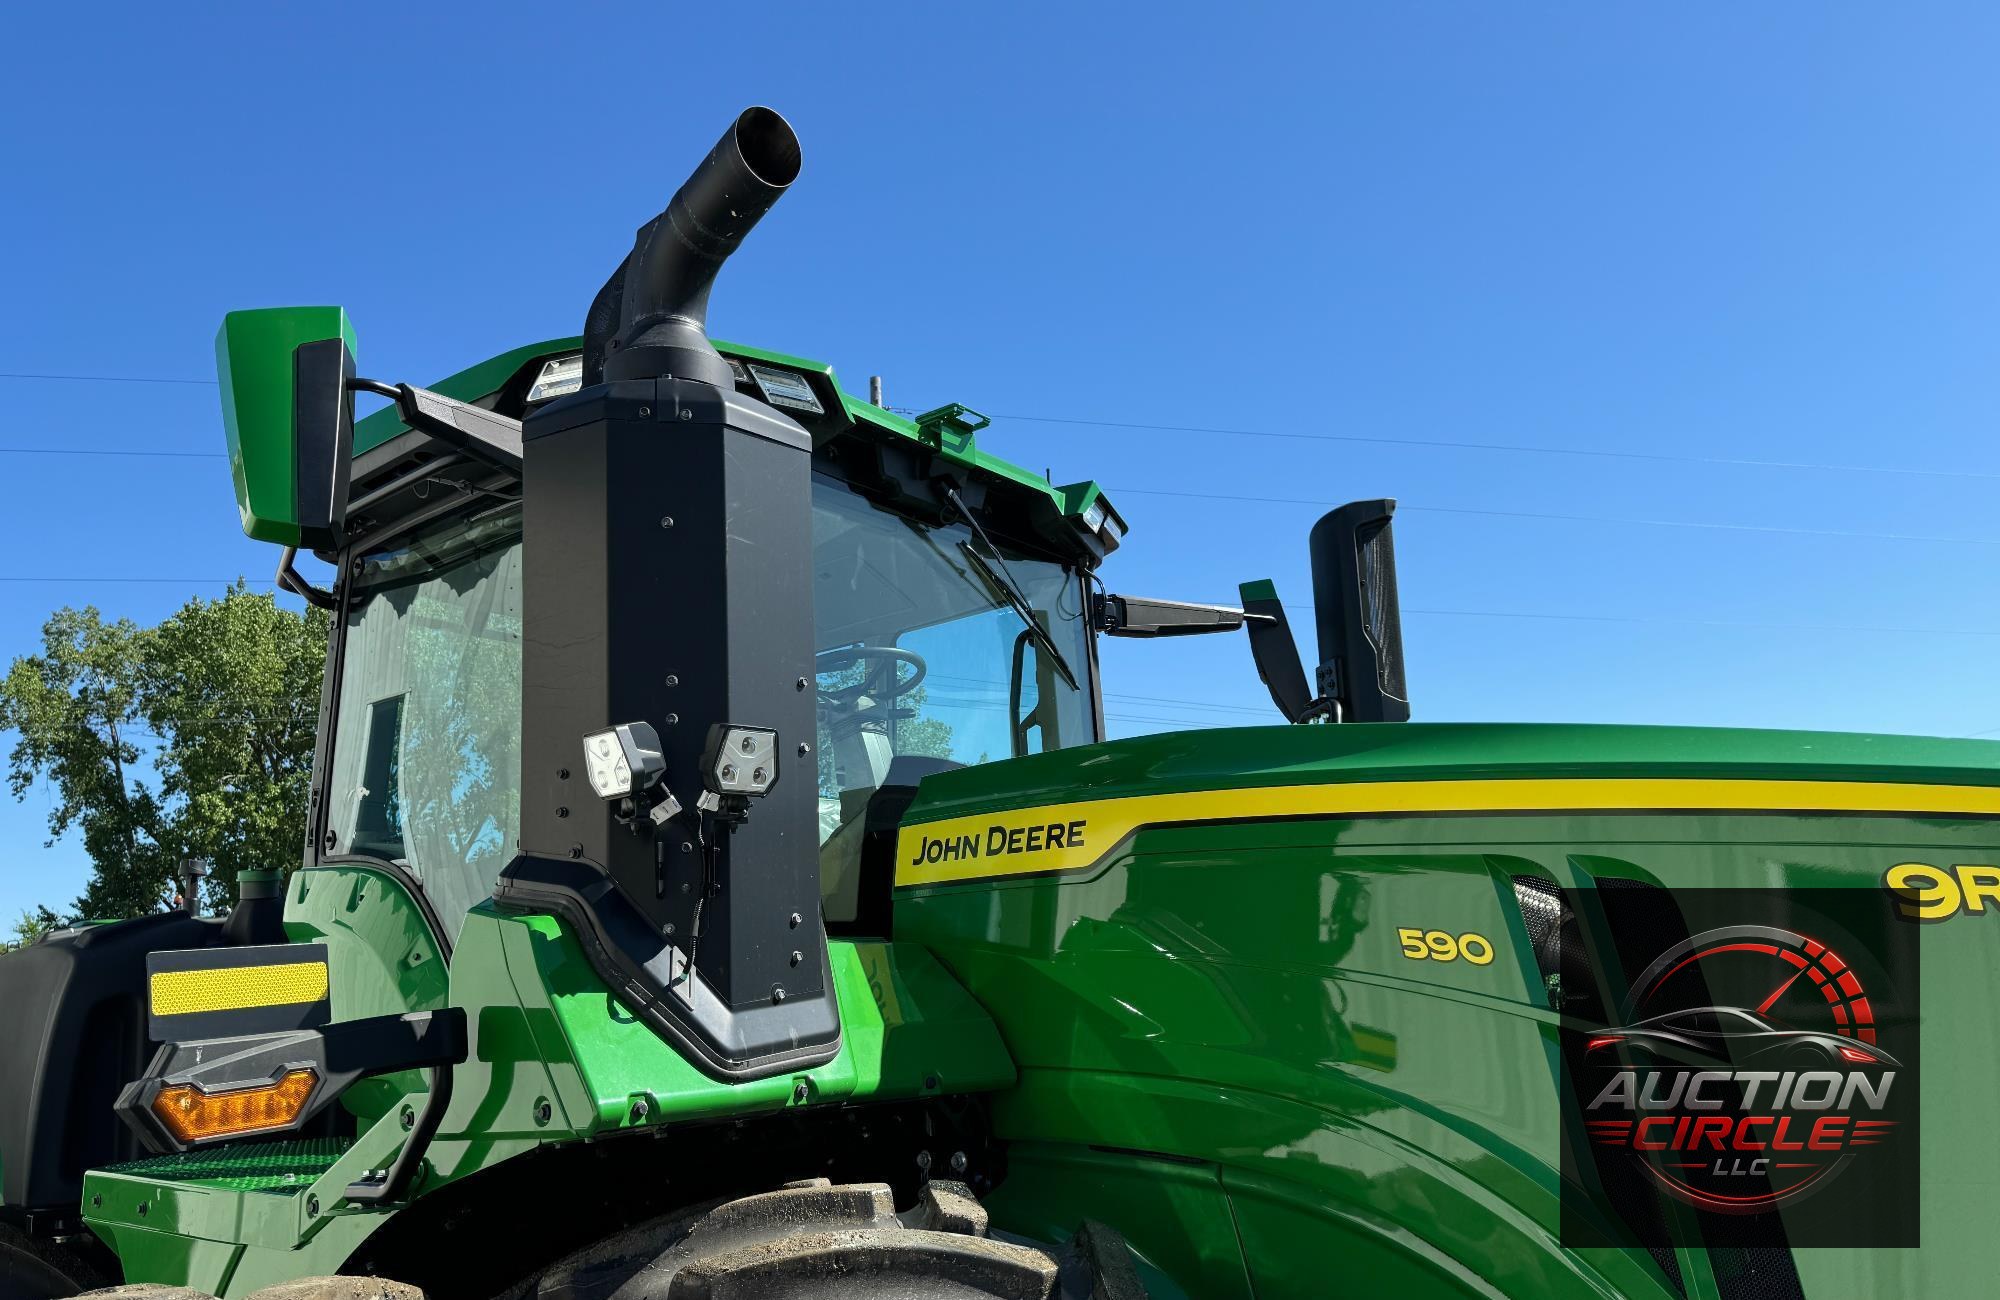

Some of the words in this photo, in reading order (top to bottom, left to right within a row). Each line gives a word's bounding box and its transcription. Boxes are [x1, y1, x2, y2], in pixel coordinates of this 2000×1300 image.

[912, 833, 981, 866] JOHN
[985, 820, 1087, 857] DEERE
[1397, 927, 1495, 966] 590
